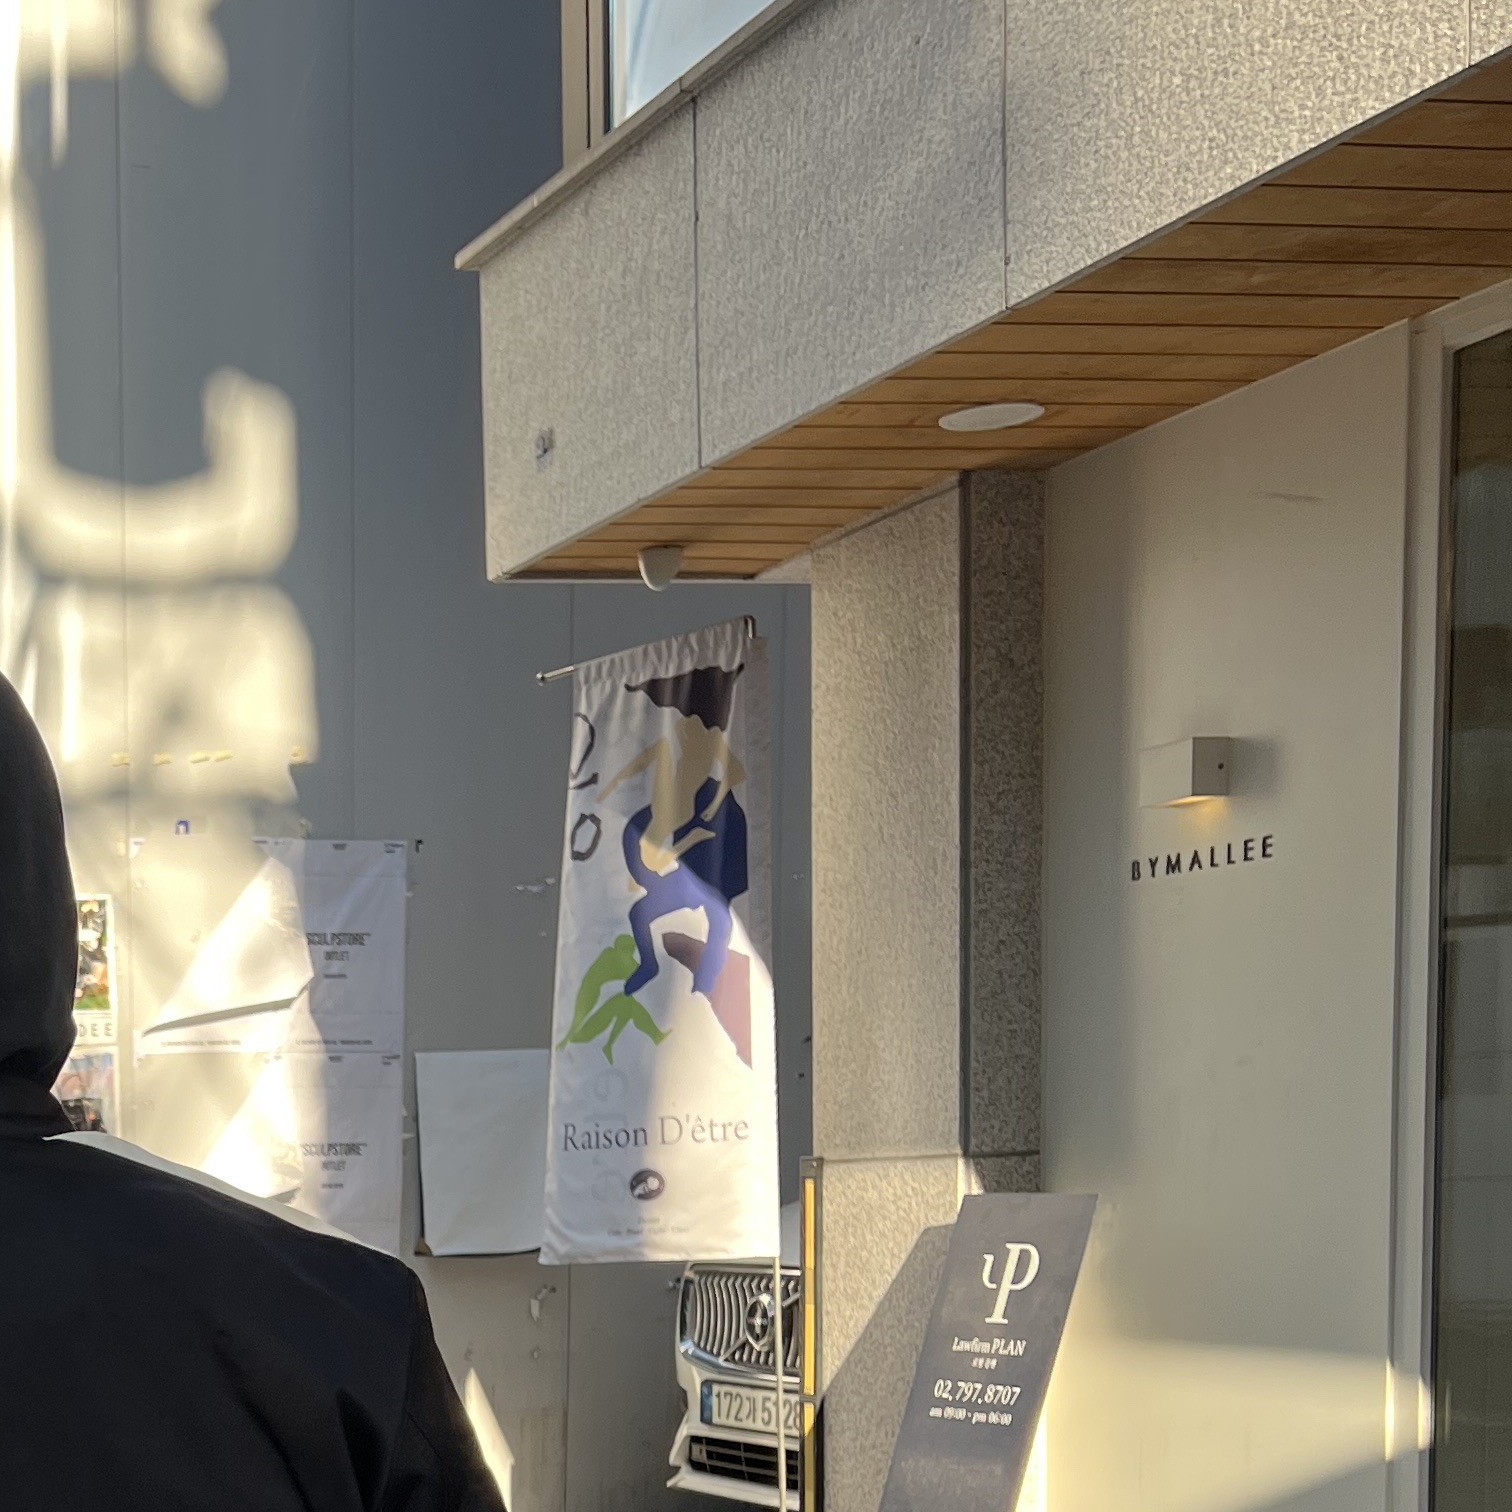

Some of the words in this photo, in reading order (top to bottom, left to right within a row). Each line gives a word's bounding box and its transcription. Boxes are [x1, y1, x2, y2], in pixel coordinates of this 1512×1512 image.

[1131, 834, 1273, 881] BYMALLEE
[563, 1122, 649, 1151] Raison
[658, 1114, 750, 1146] D'être
[952, 1336, 991, 1353] Lawfirm
[991, 1337, 1027, 1356] PLAN
[934, 1378, 1022, 1406] 02.797.8707
